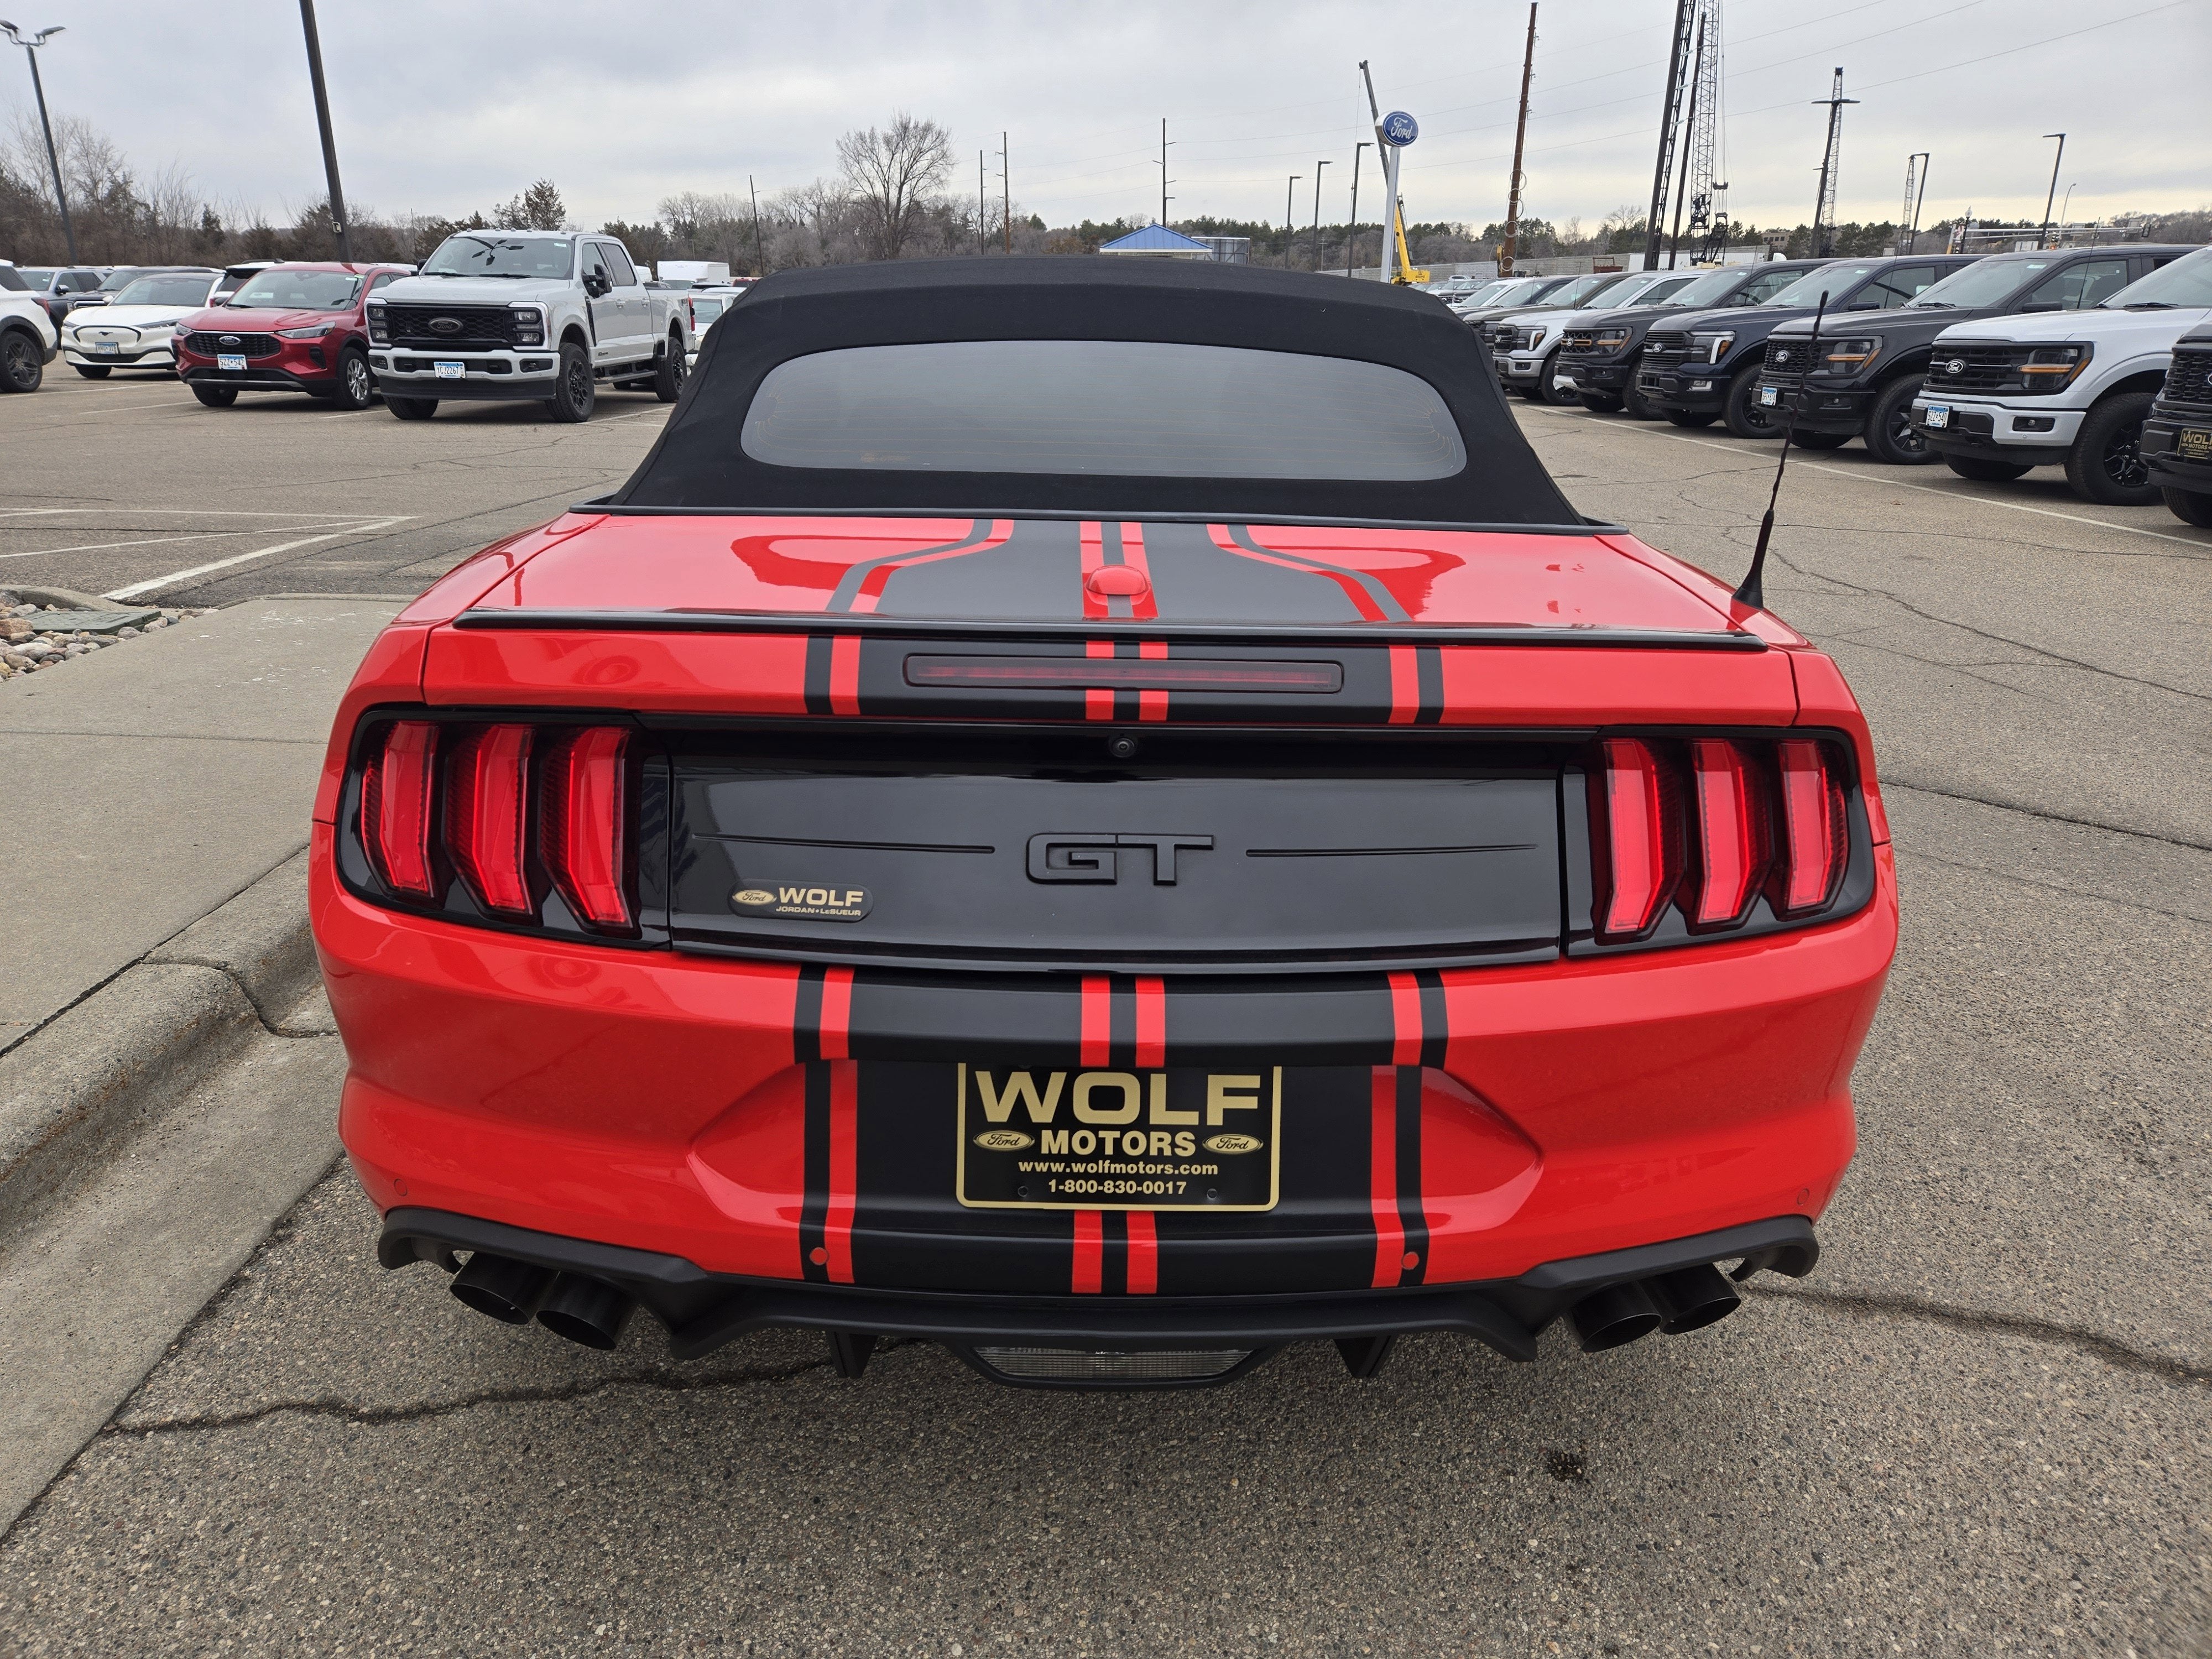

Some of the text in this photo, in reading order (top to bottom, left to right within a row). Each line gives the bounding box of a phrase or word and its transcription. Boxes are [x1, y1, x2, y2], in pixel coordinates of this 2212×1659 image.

[1390, 117, 1412, 139] Ford
[1026, 832, 1214, 885] GT
[779, 887, 863, 906] WOLF
[975, 1071, 1260, 1126] WOLF
[1041, 1129, 1196, 1157] MOTORS
[1018, 1160, 1218, 1175] www.wolfmotors.com
[1048, 1179, 1187, 1194] 1-800-830-0017
